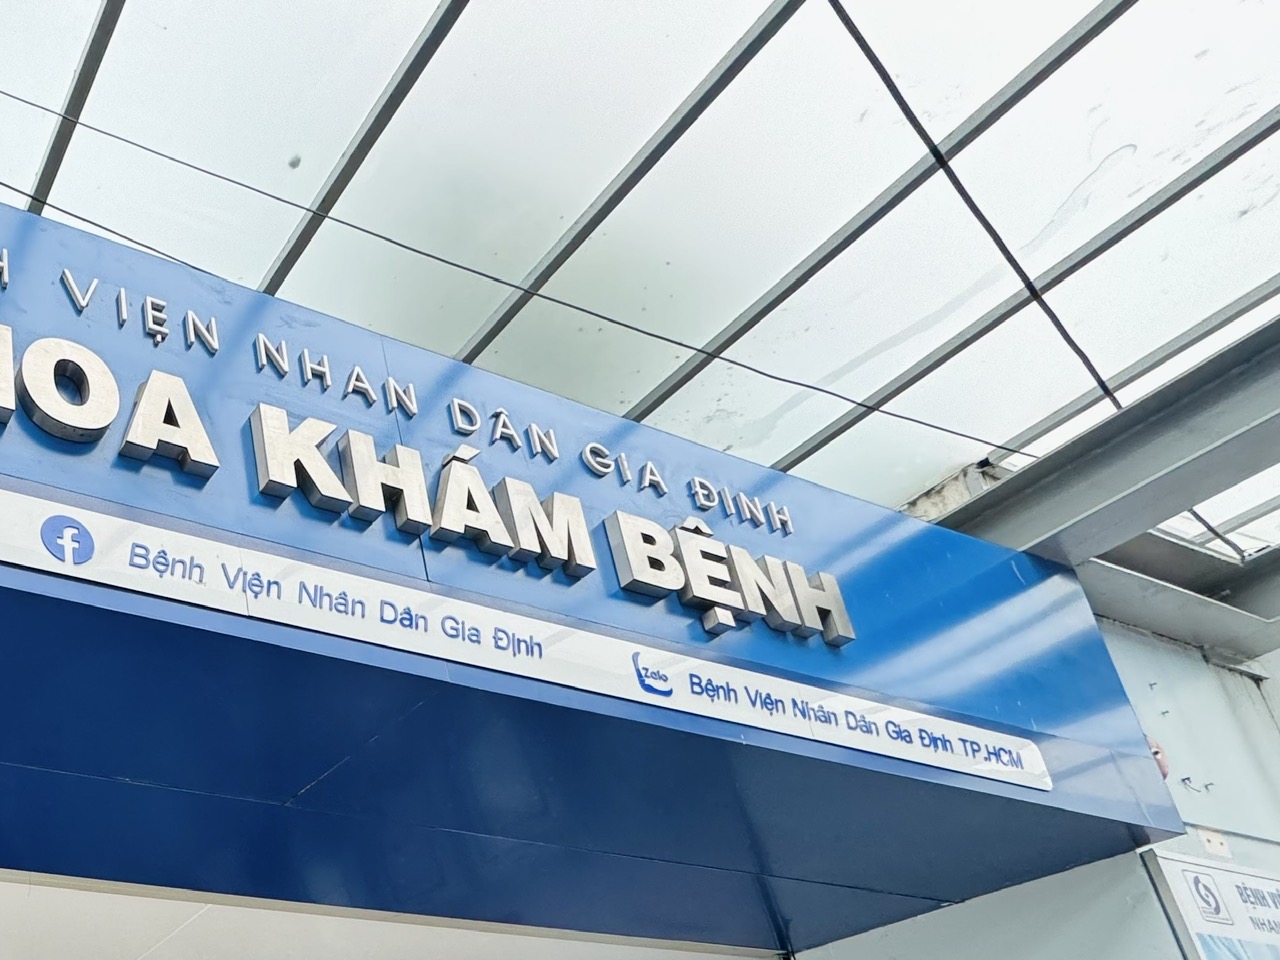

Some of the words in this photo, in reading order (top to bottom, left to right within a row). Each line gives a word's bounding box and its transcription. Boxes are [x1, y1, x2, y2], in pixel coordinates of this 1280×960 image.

[449, 397, 560, 461] DÂN
[581, 441, 669, 498] GIA
[249, 402, 597, 580] KHÁM
[603, 509, 857, 648] BỆNH
[128, 541, 205, 583] Bệnh
[221, 561, 282, 600] Viện
[298, 580, 366, 619] Nhân
[380, 599, 429, 634] Dân
[441, 615, 482, 646] Gia
[493, 628, 543, 660] Định
[688, 672, 738, 703] Bệnh
[744, 685, 786, 716] Viện
[791, 697, 839, 727] Nhân
[844, 710, 880, 737] Dân
[885, 719, 914, 745] Gia
[918, 728, 954, 754] Định
[958, 737, 1025, 770] TP.HCM
